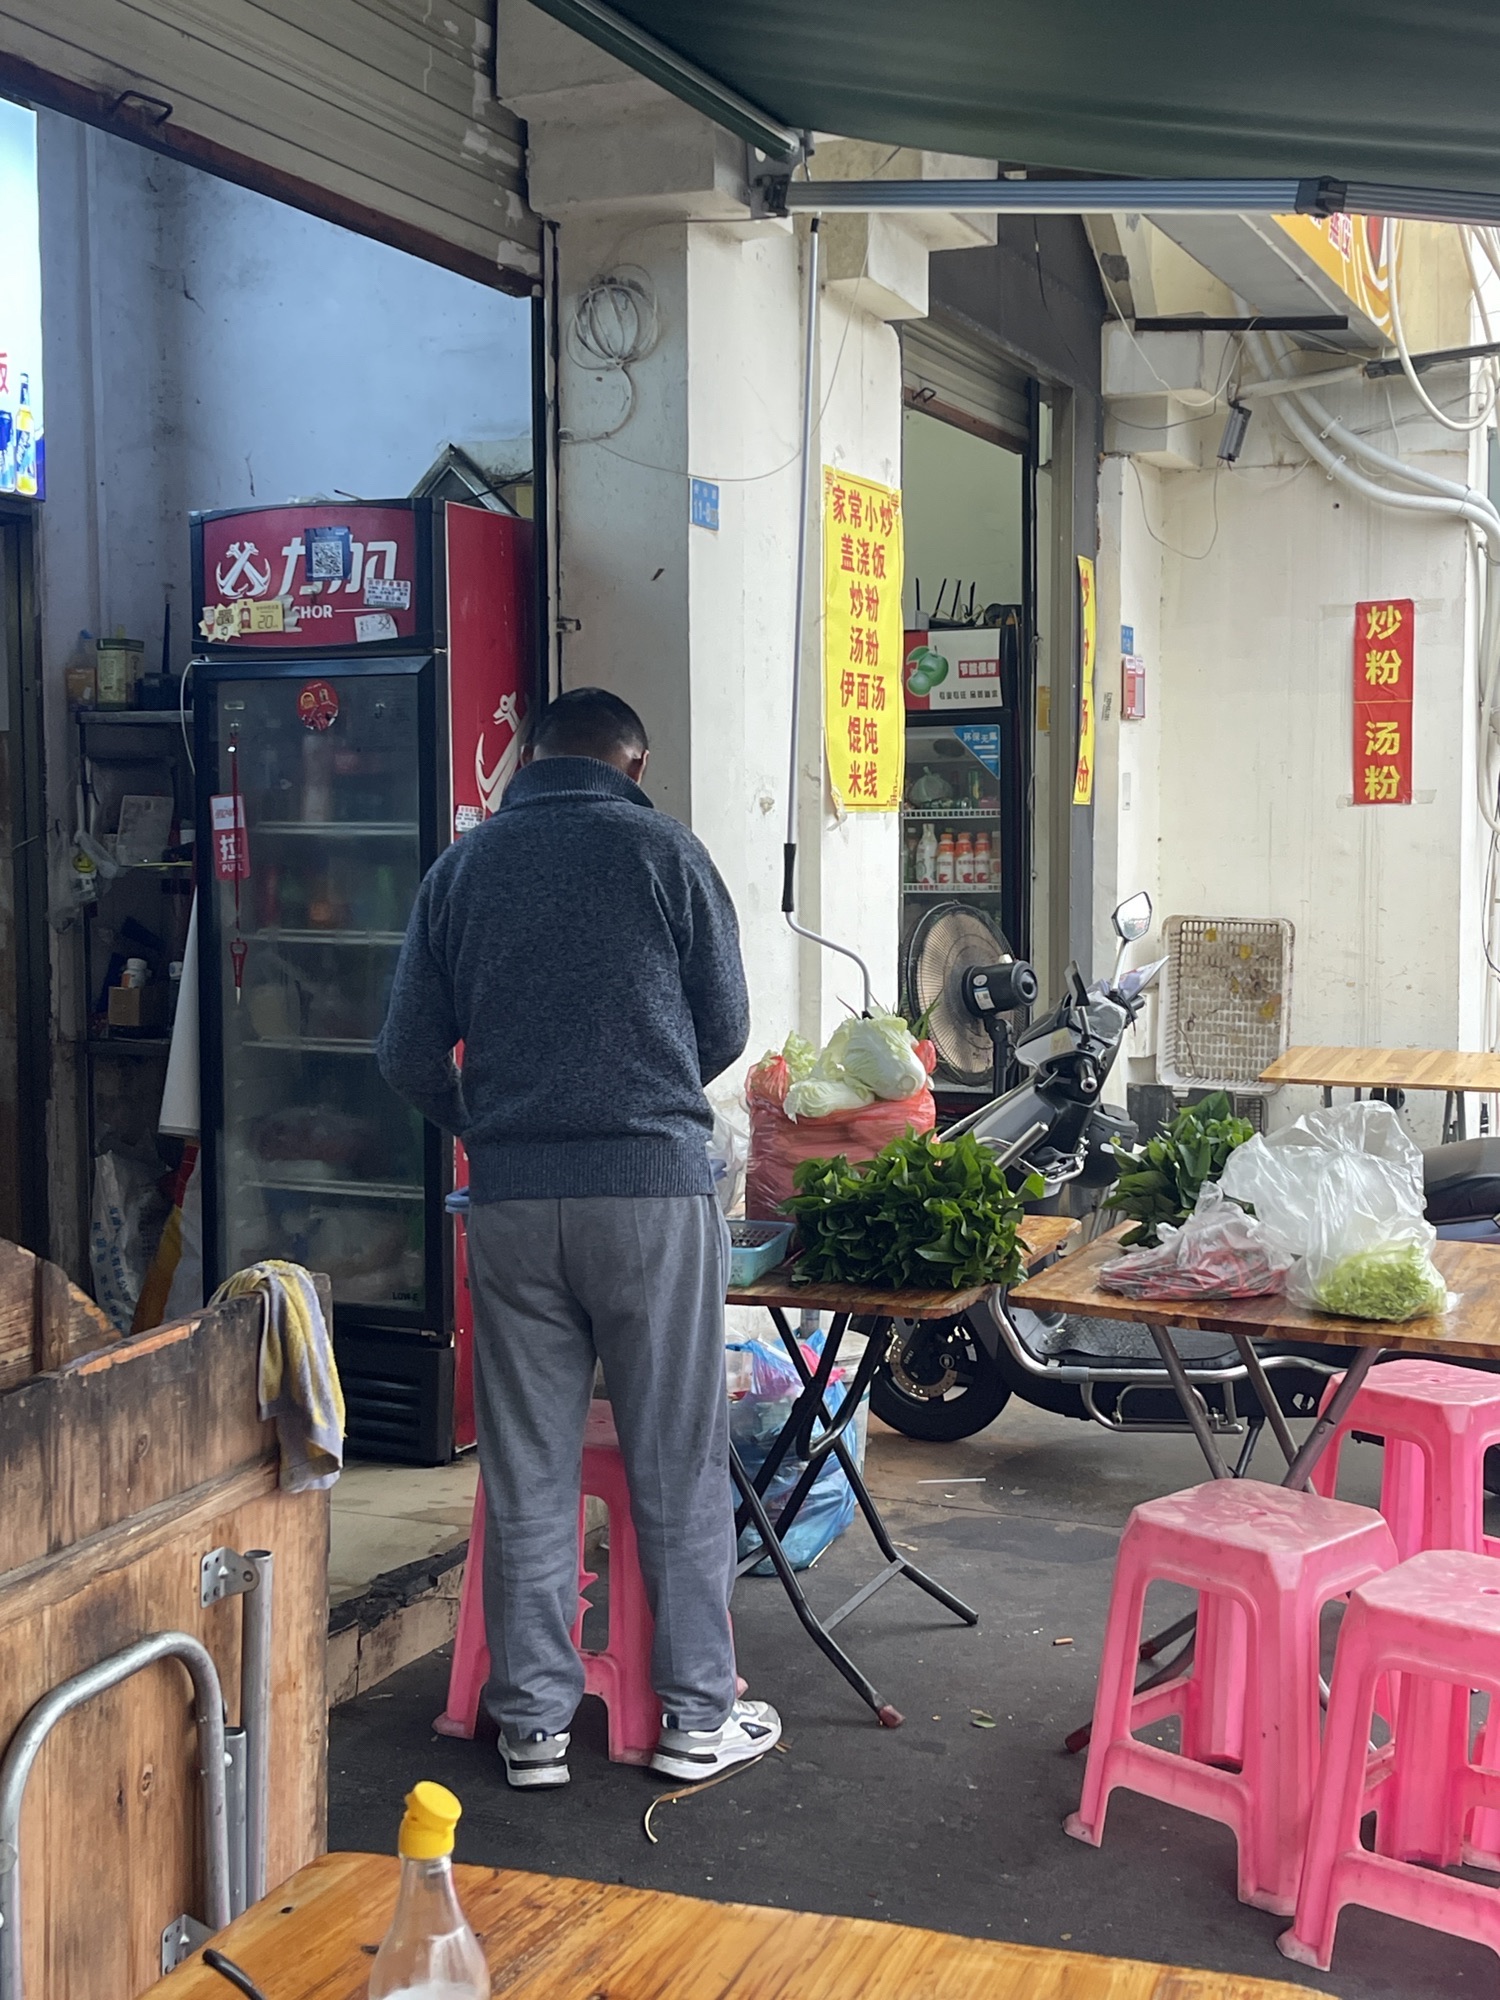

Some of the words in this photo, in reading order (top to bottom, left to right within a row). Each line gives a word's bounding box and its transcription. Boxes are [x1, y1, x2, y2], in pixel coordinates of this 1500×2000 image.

[832, 484, 893, 538] 家常小炒
[840, 532, 887, 580] 盖浇饭
[849, 579, 880, 623] 炒粉
[849, 625, 880, 667] 汤粉
[1365, 604, 1403, 686] 炒粉
[840, 668, 887, 712] 伊面汤
[847, 714, 879, 755] 馄饨
[848, 760, 879, 799] 米线
[1364, 721, 1401, 801] 汤粉
[221, 863, 244, 873] PUL
